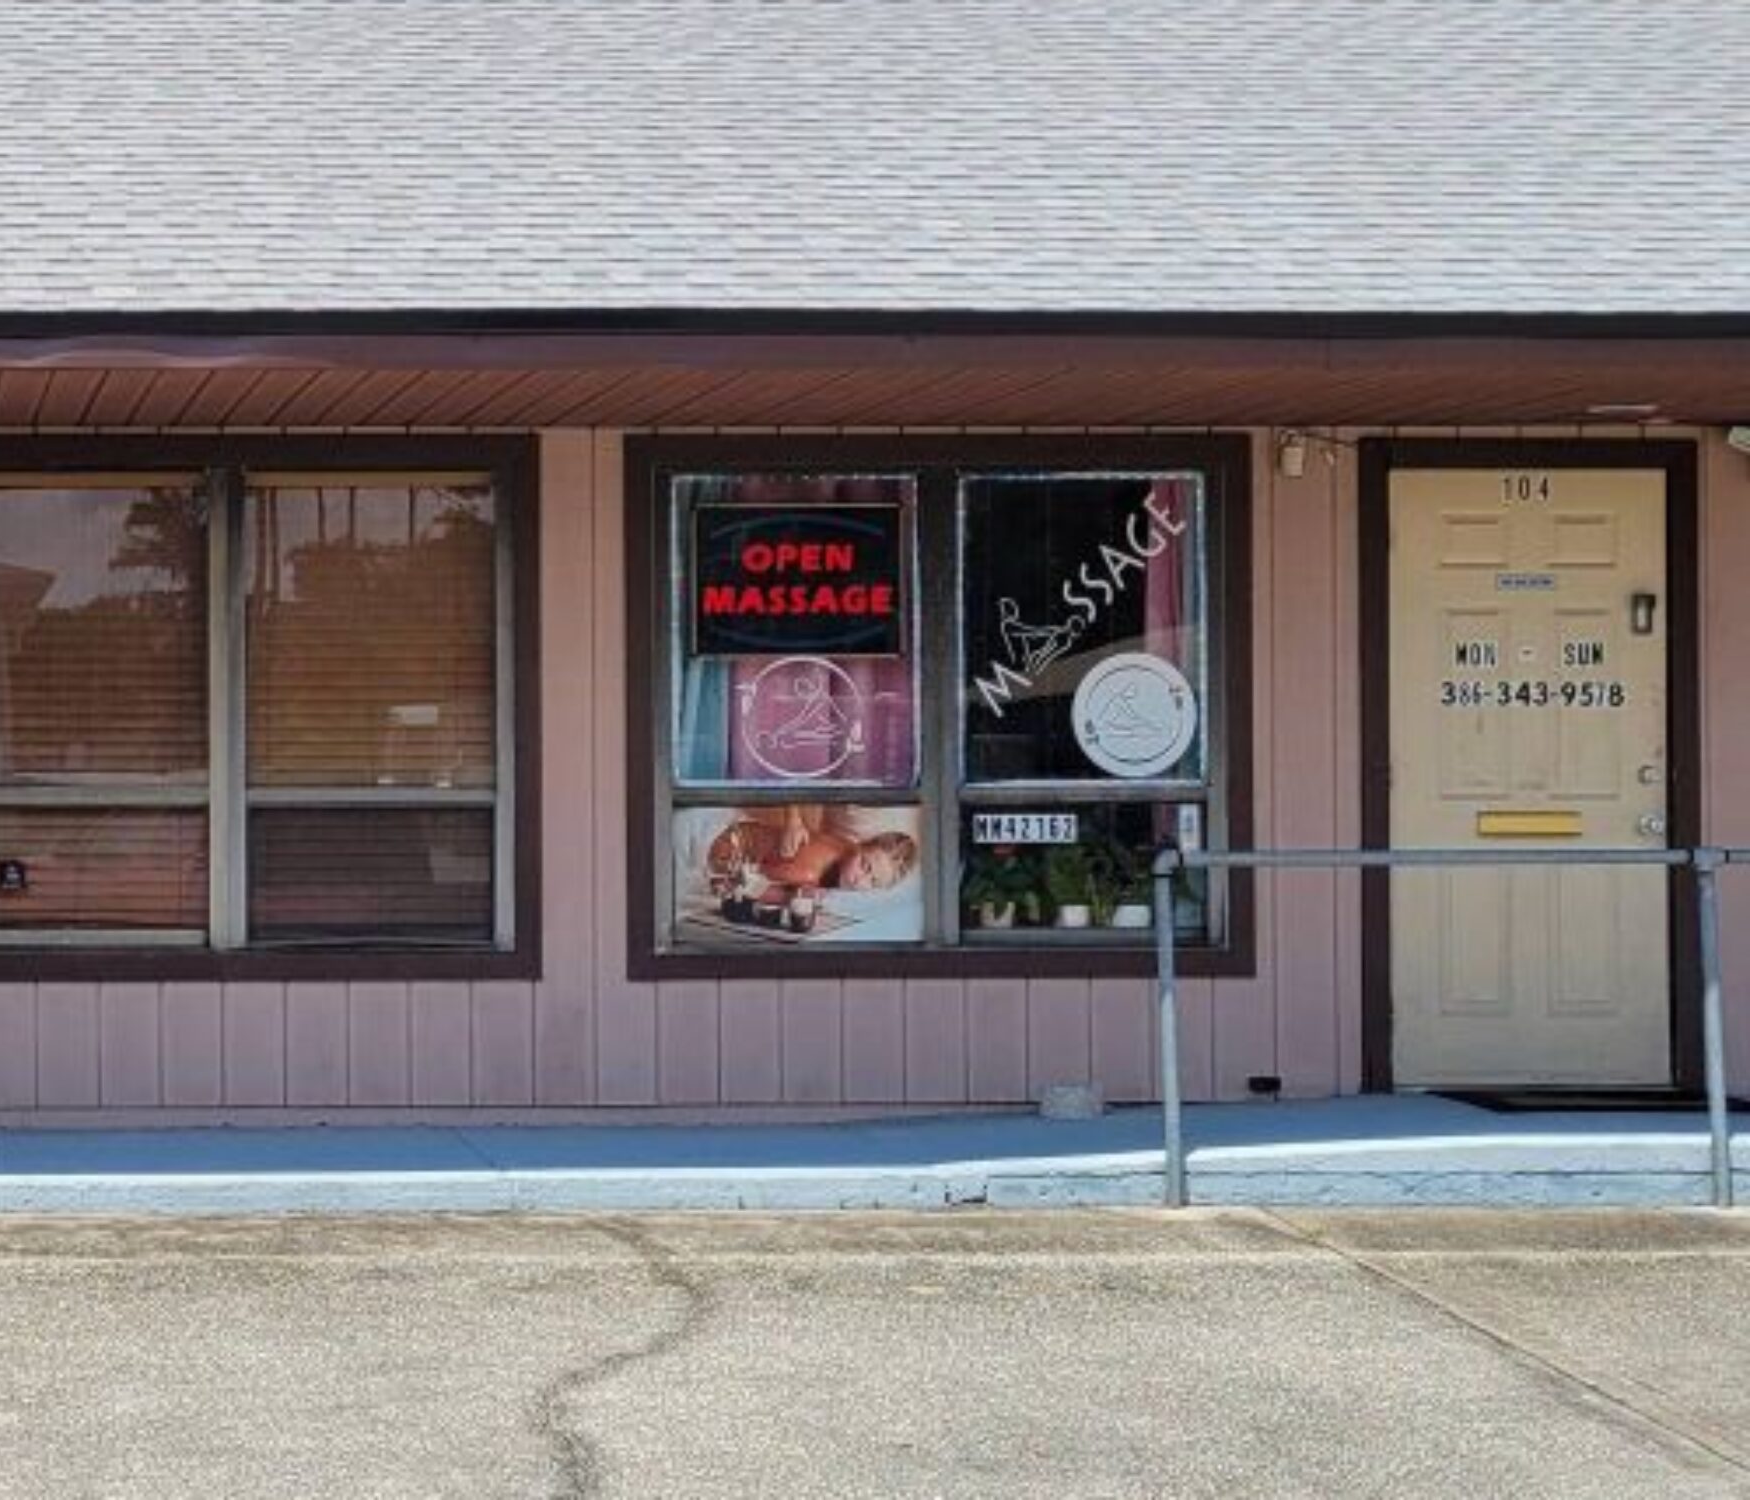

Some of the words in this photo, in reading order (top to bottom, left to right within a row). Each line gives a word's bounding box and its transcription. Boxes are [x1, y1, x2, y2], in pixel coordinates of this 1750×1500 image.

[1503, 476, 1549, 501] 104
[741, 541, 855, 573] OPEN
[702, 584, 893, 615] MASSAGE
[1456, 642, 1496, 666] MON
[1563, 642, 1604, 666] SUN
